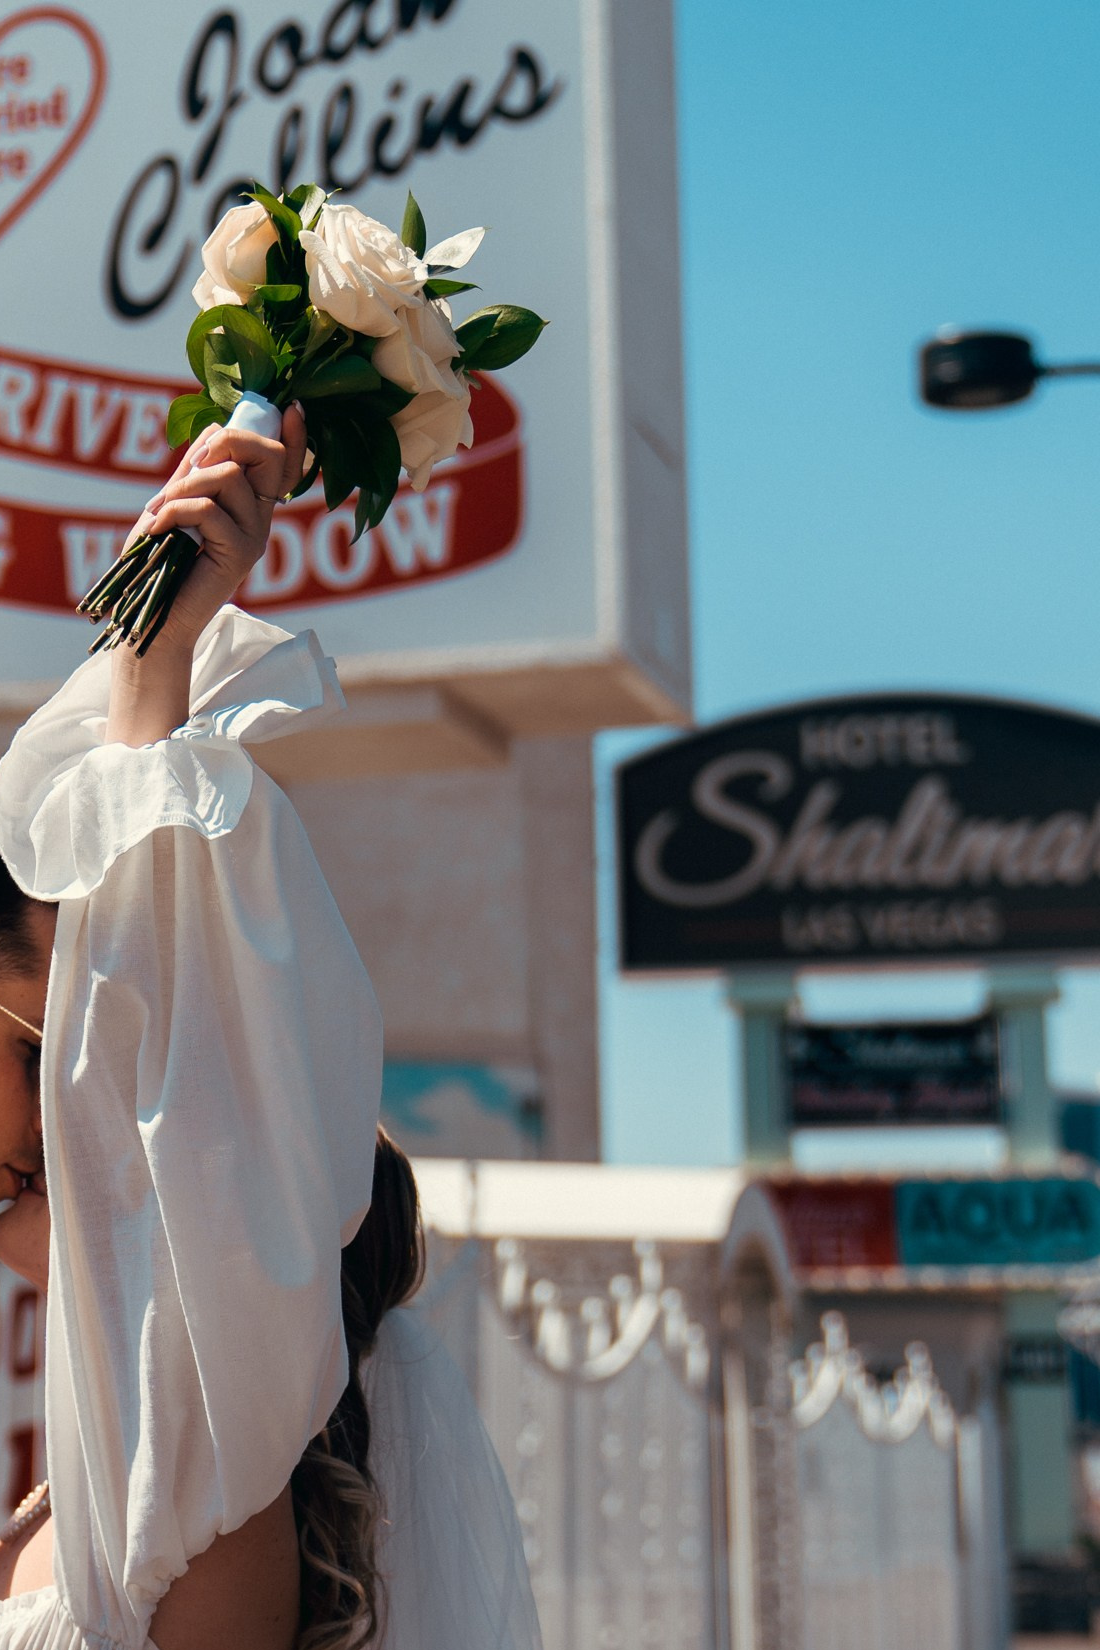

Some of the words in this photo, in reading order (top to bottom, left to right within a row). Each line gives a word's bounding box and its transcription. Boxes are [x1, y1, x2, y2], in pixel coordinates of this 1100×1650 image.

[60, 480, 458, 601] WDOW
[801, 712, 968, 768] HOTEL
[635, 749, 1100, 908] Shalima
[781, 905, 856, 949] LAS
[858, 897, 1001, 945] VEGAS
[910, 1188, 1094, 1244] AQUA
